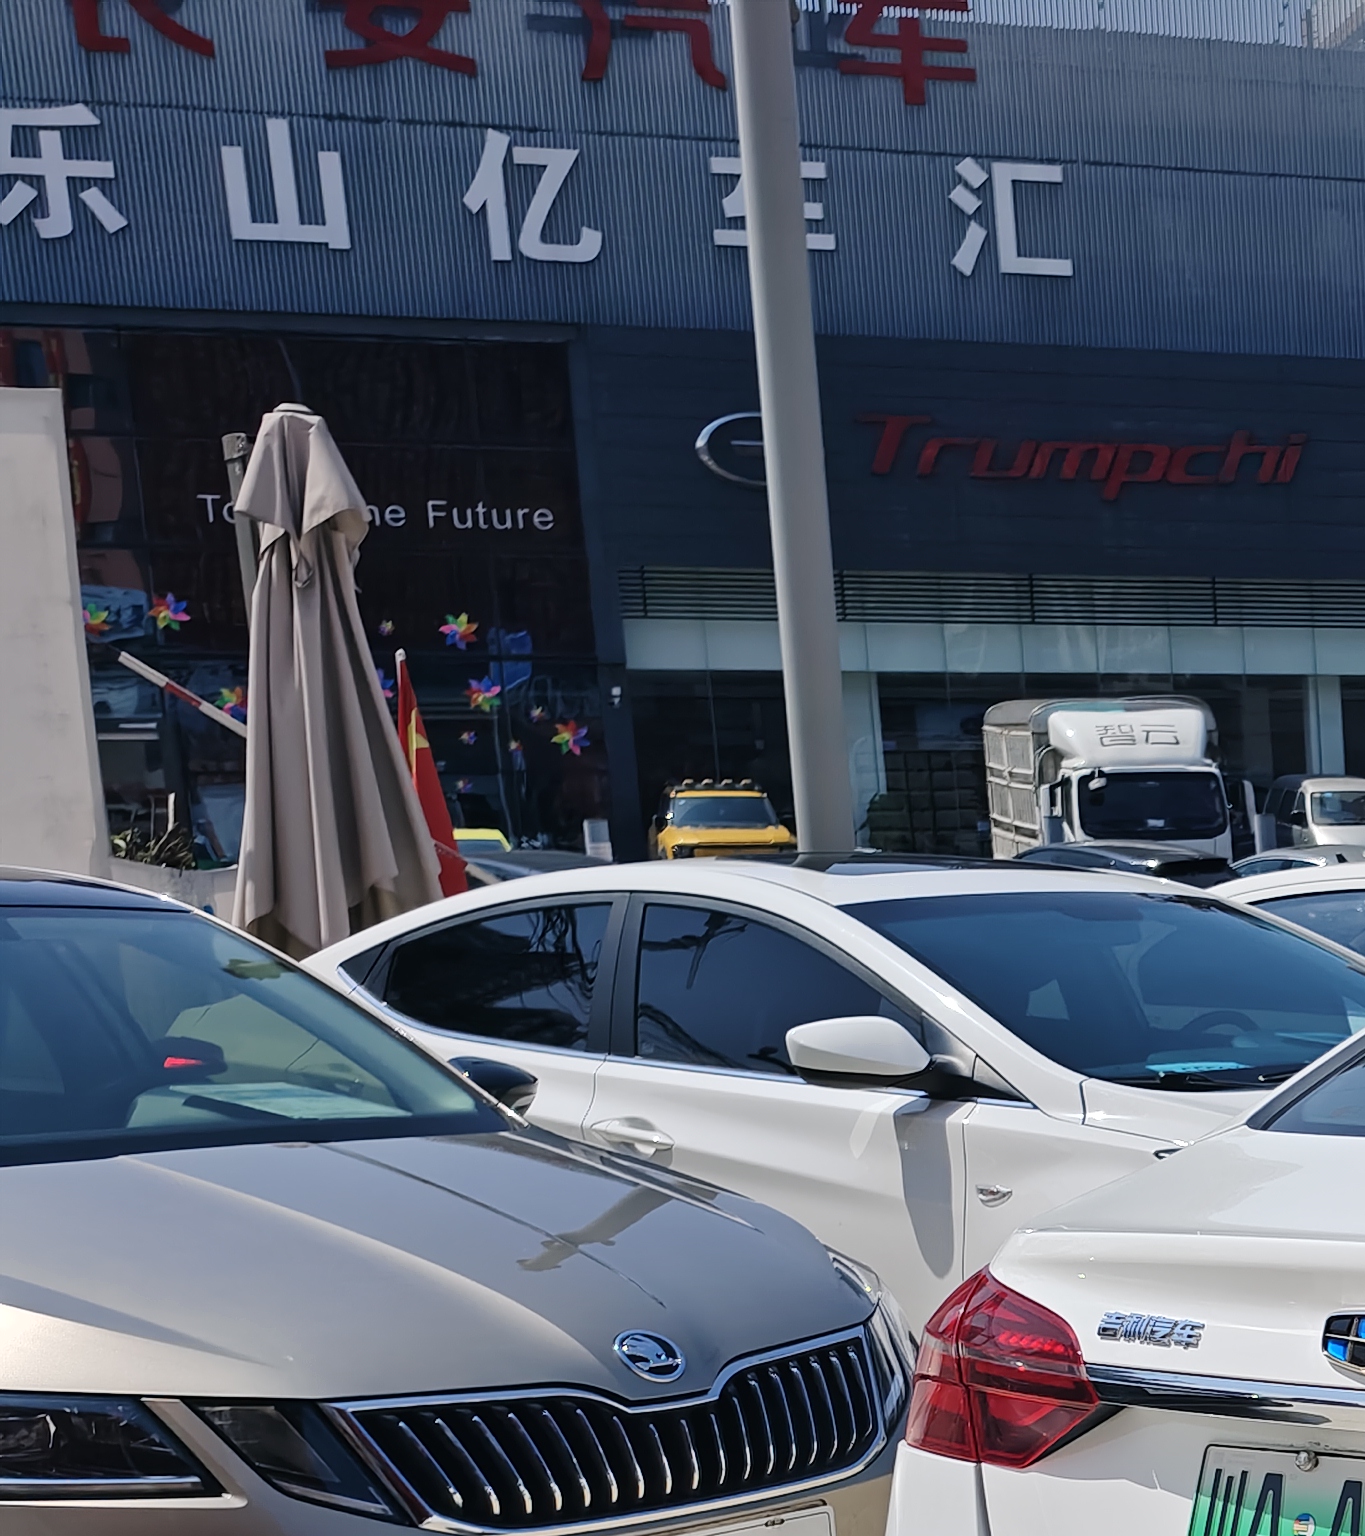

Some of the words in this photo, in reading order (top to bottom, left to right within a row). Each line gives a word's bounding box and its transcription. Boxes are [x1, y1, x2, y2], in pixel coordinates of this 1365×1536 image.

[853, 413, 1307, 500] Trumpchi
[426, 500, 555, 531] Future
[1095, 724, 1181, 747] 智云
